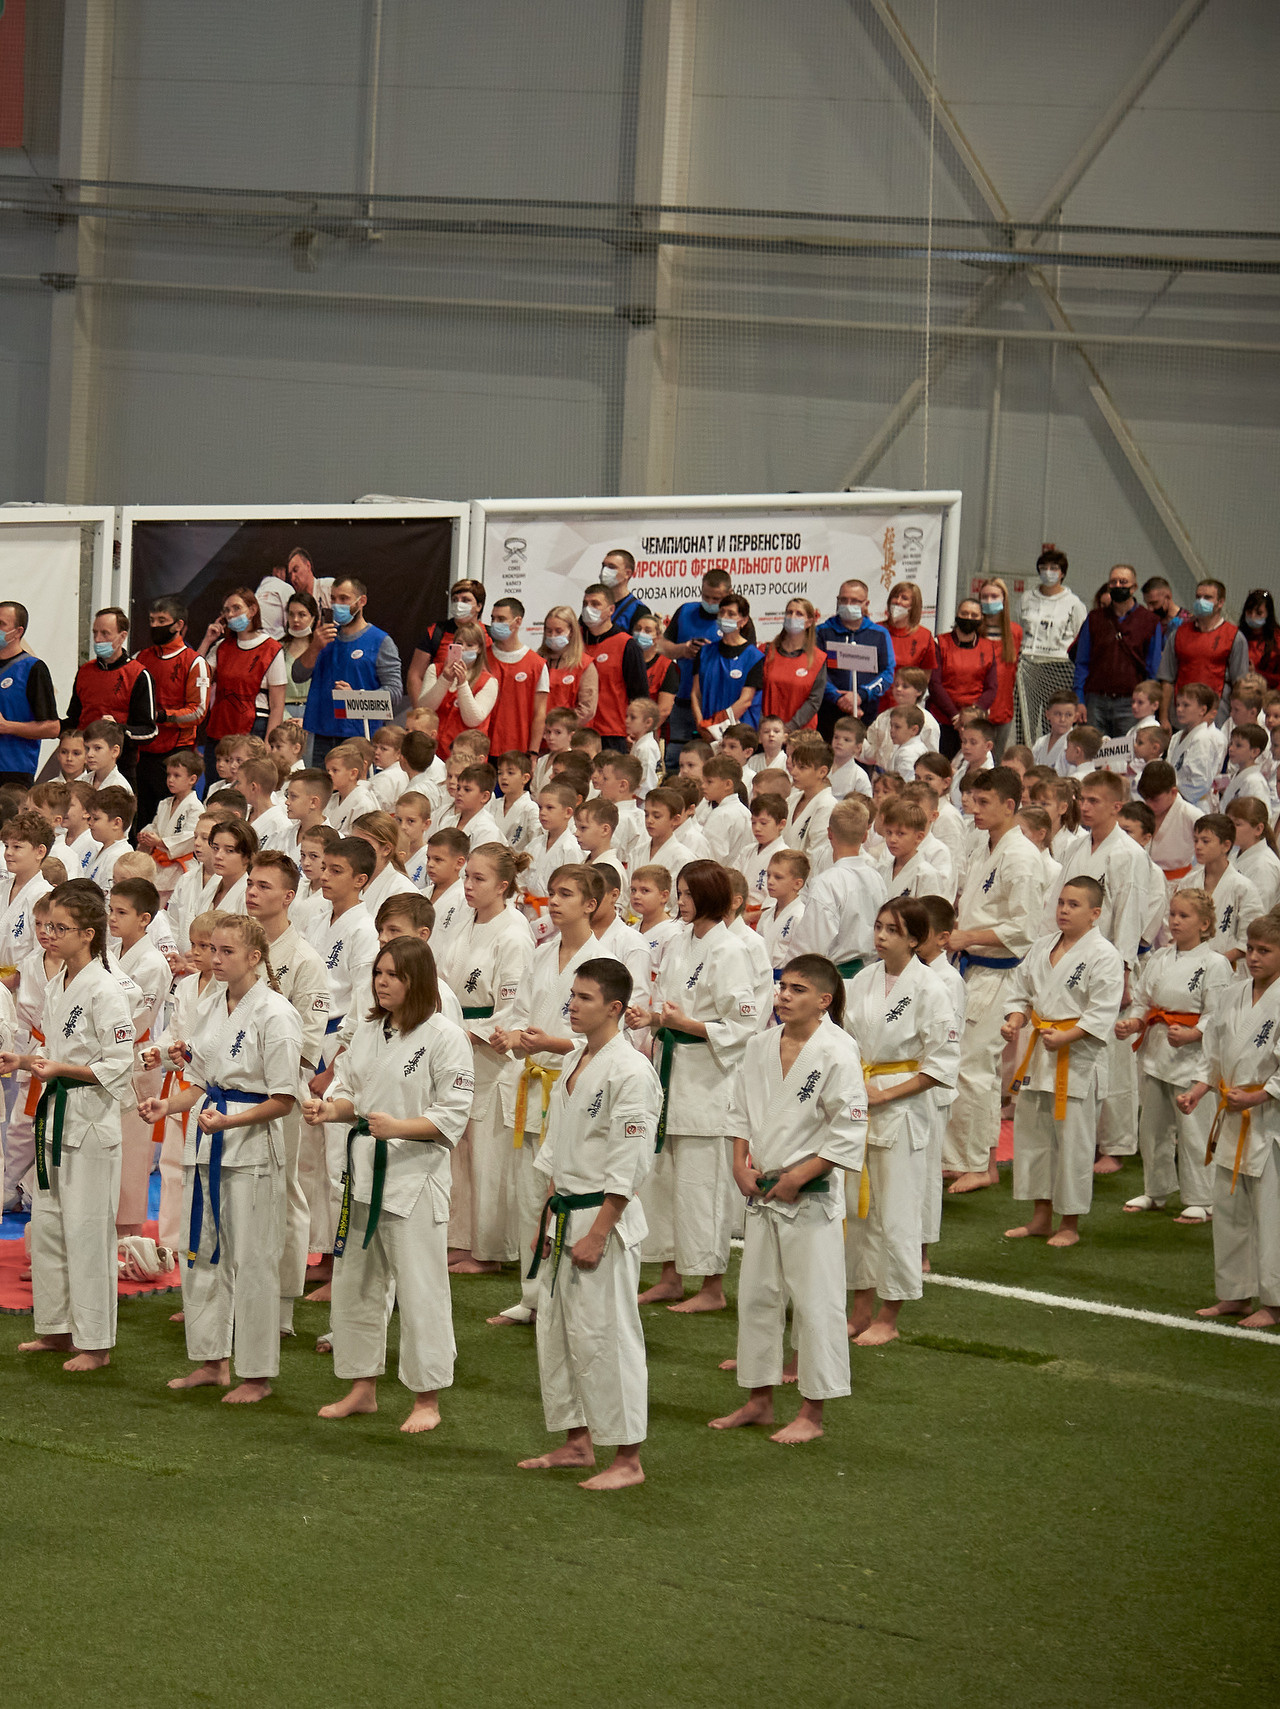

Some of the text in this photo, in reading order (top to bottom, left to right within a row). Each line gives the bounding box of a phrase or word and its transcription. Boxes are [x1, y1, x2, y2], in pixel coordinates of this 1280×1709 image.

[641, 533, 802, 555] ЧЕМПИОНАТ И ПЕРВЕНСТВО
[632, 560, 687, 578] ИРСКОГО
[785, 554, 830, 573] ОКРУГА
[631, 586, 667, 600] СОЮЗА
[669, 585, 703, 599] КИОКУ
[769, 581, 808, 595] РОССИИ
[346, 699, 390, 711] NOVOSIBIRSK
